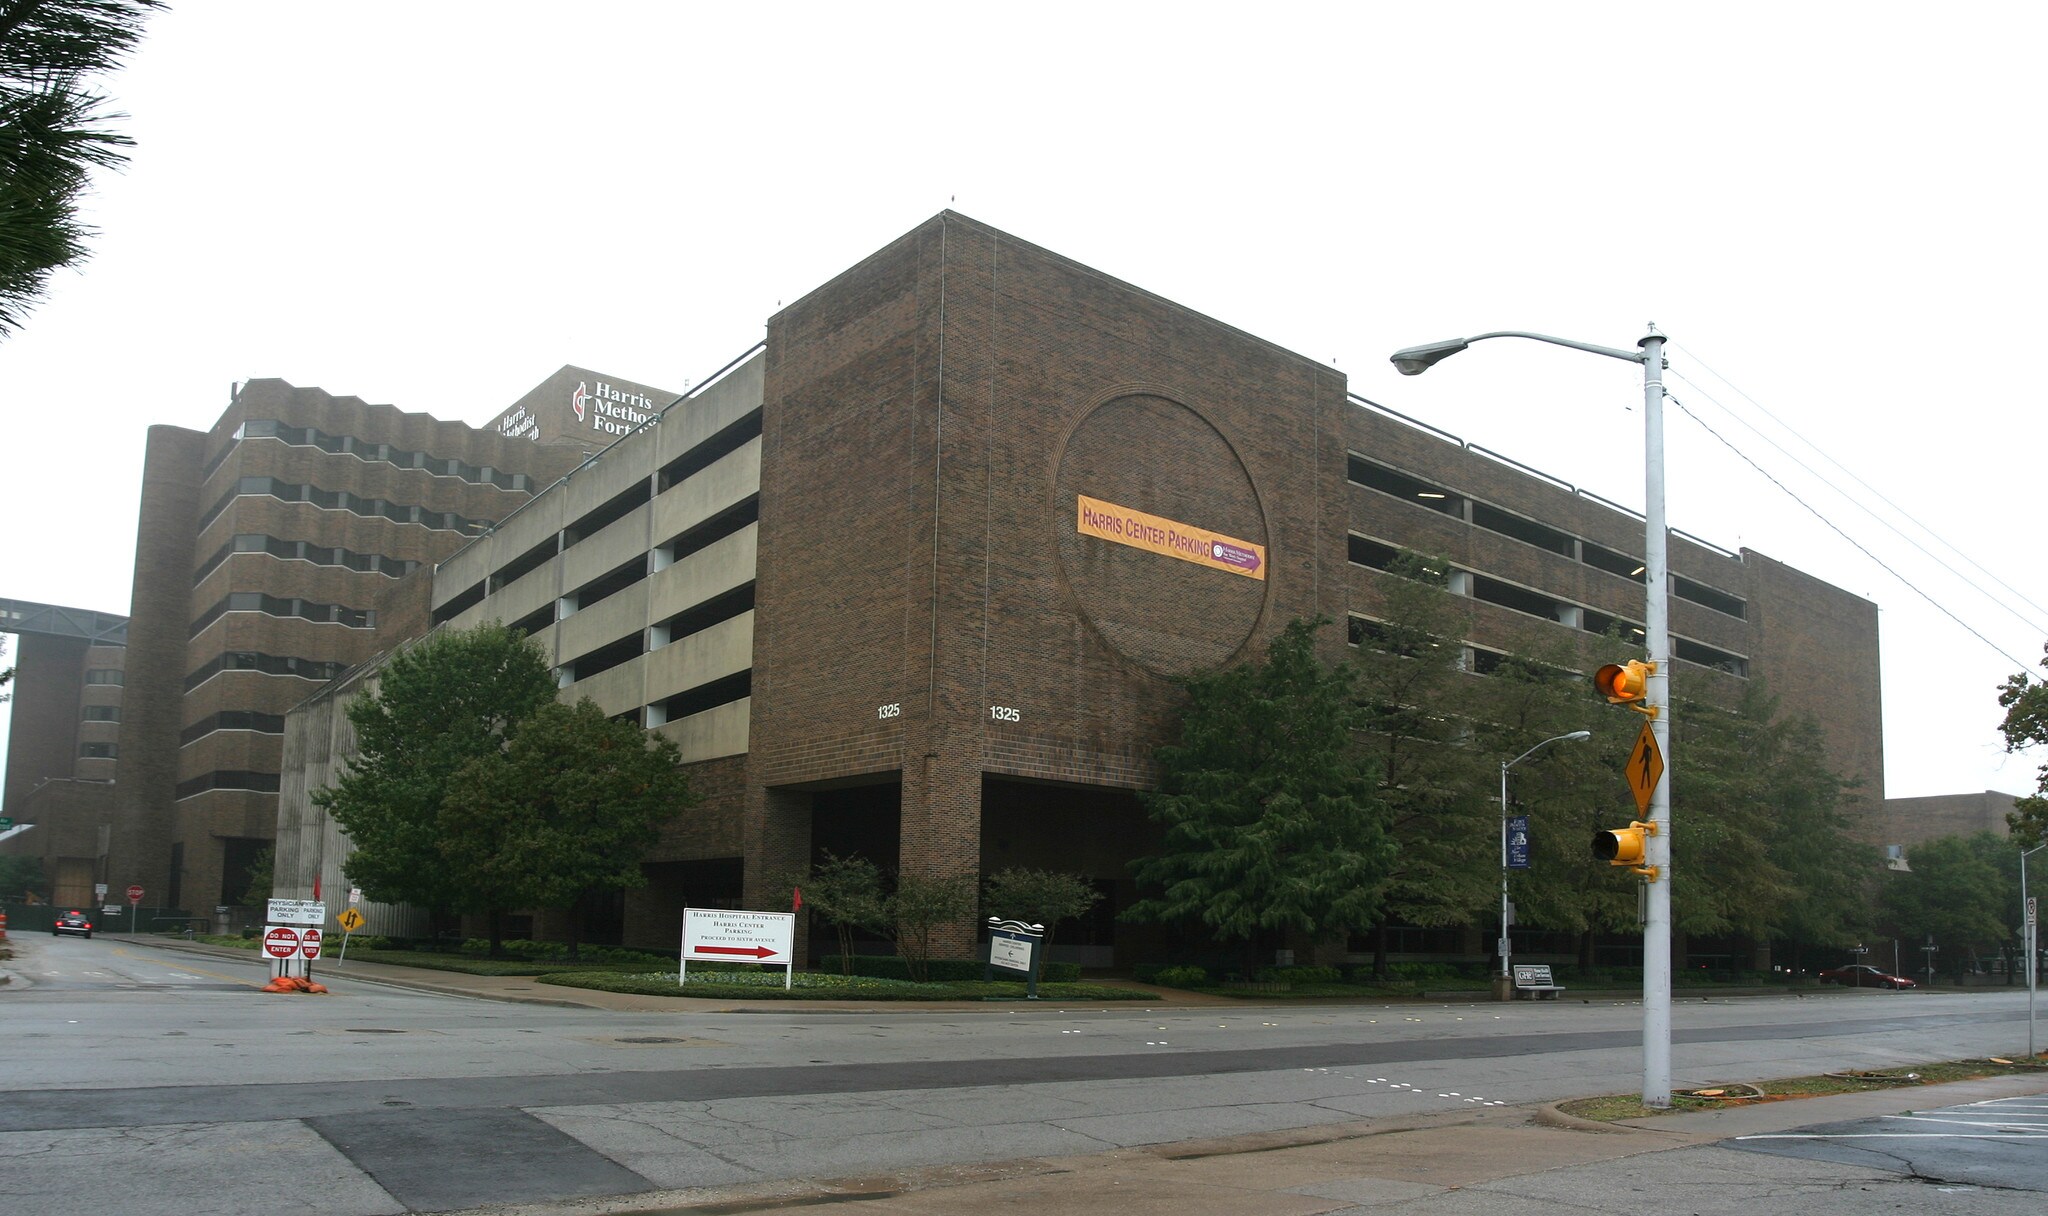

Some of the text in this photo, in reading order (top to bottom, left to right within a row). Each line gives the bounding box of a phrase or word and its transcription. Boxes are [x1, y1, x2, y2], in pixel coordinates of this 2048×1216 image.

[595, 382, 652, 410] Harris
[503, 405, 526, 431] Harris
[592, 414, 632, 436] Fort
[1083, 506, 1210, 557] HARRIS CENTER PARKING
[878, 703, 900, 719] 1325
[990, 705, 1020, 722] 1325
